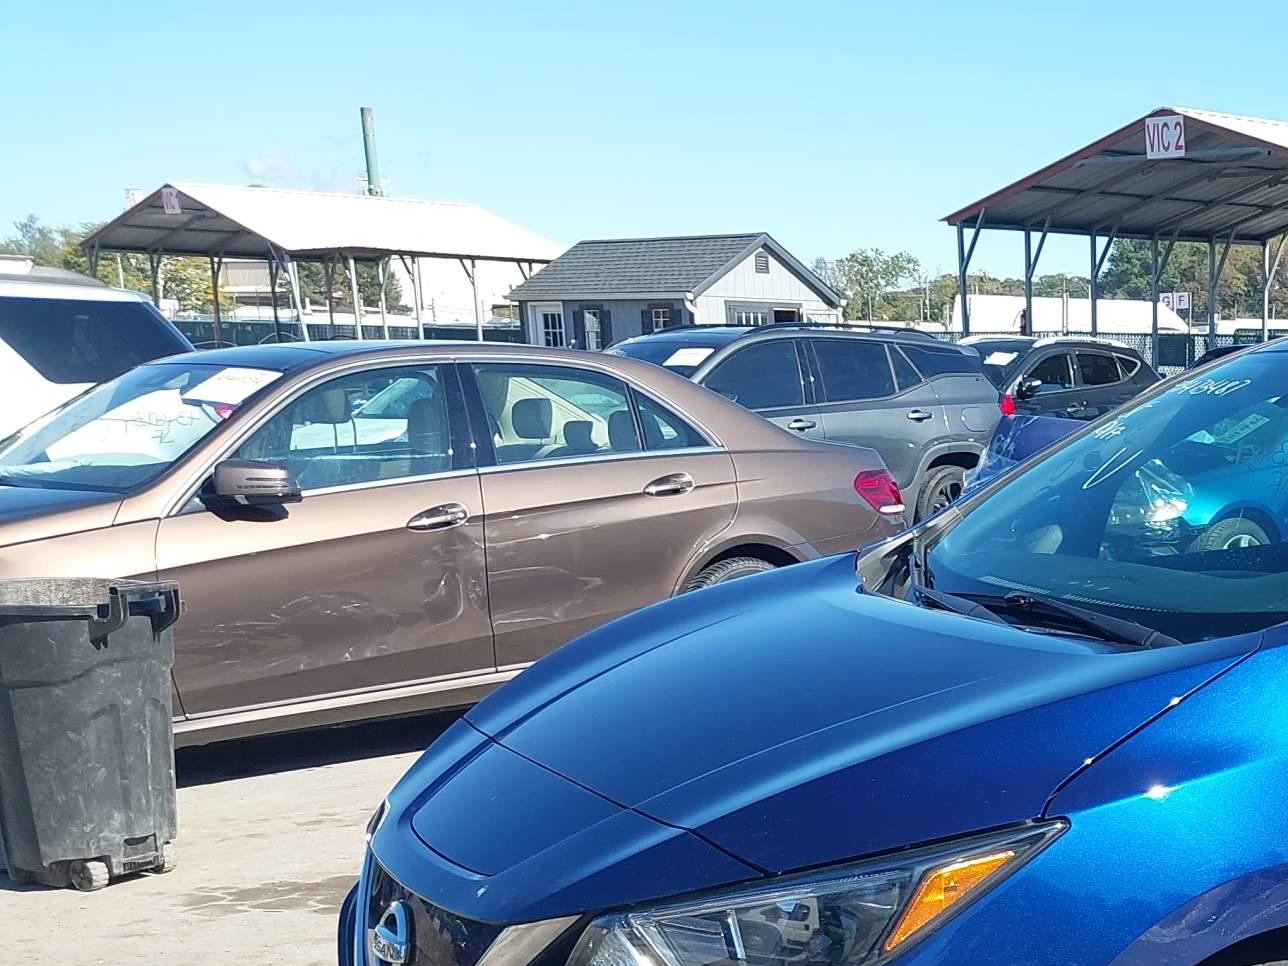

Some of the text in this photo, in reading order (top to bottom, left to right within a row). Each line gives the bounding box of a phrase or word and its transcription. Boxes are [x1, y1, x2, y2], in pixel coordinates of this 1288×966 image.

[1147, 121, 1184, 152] VIC 2
[1178, 295, 1185, 306] F
